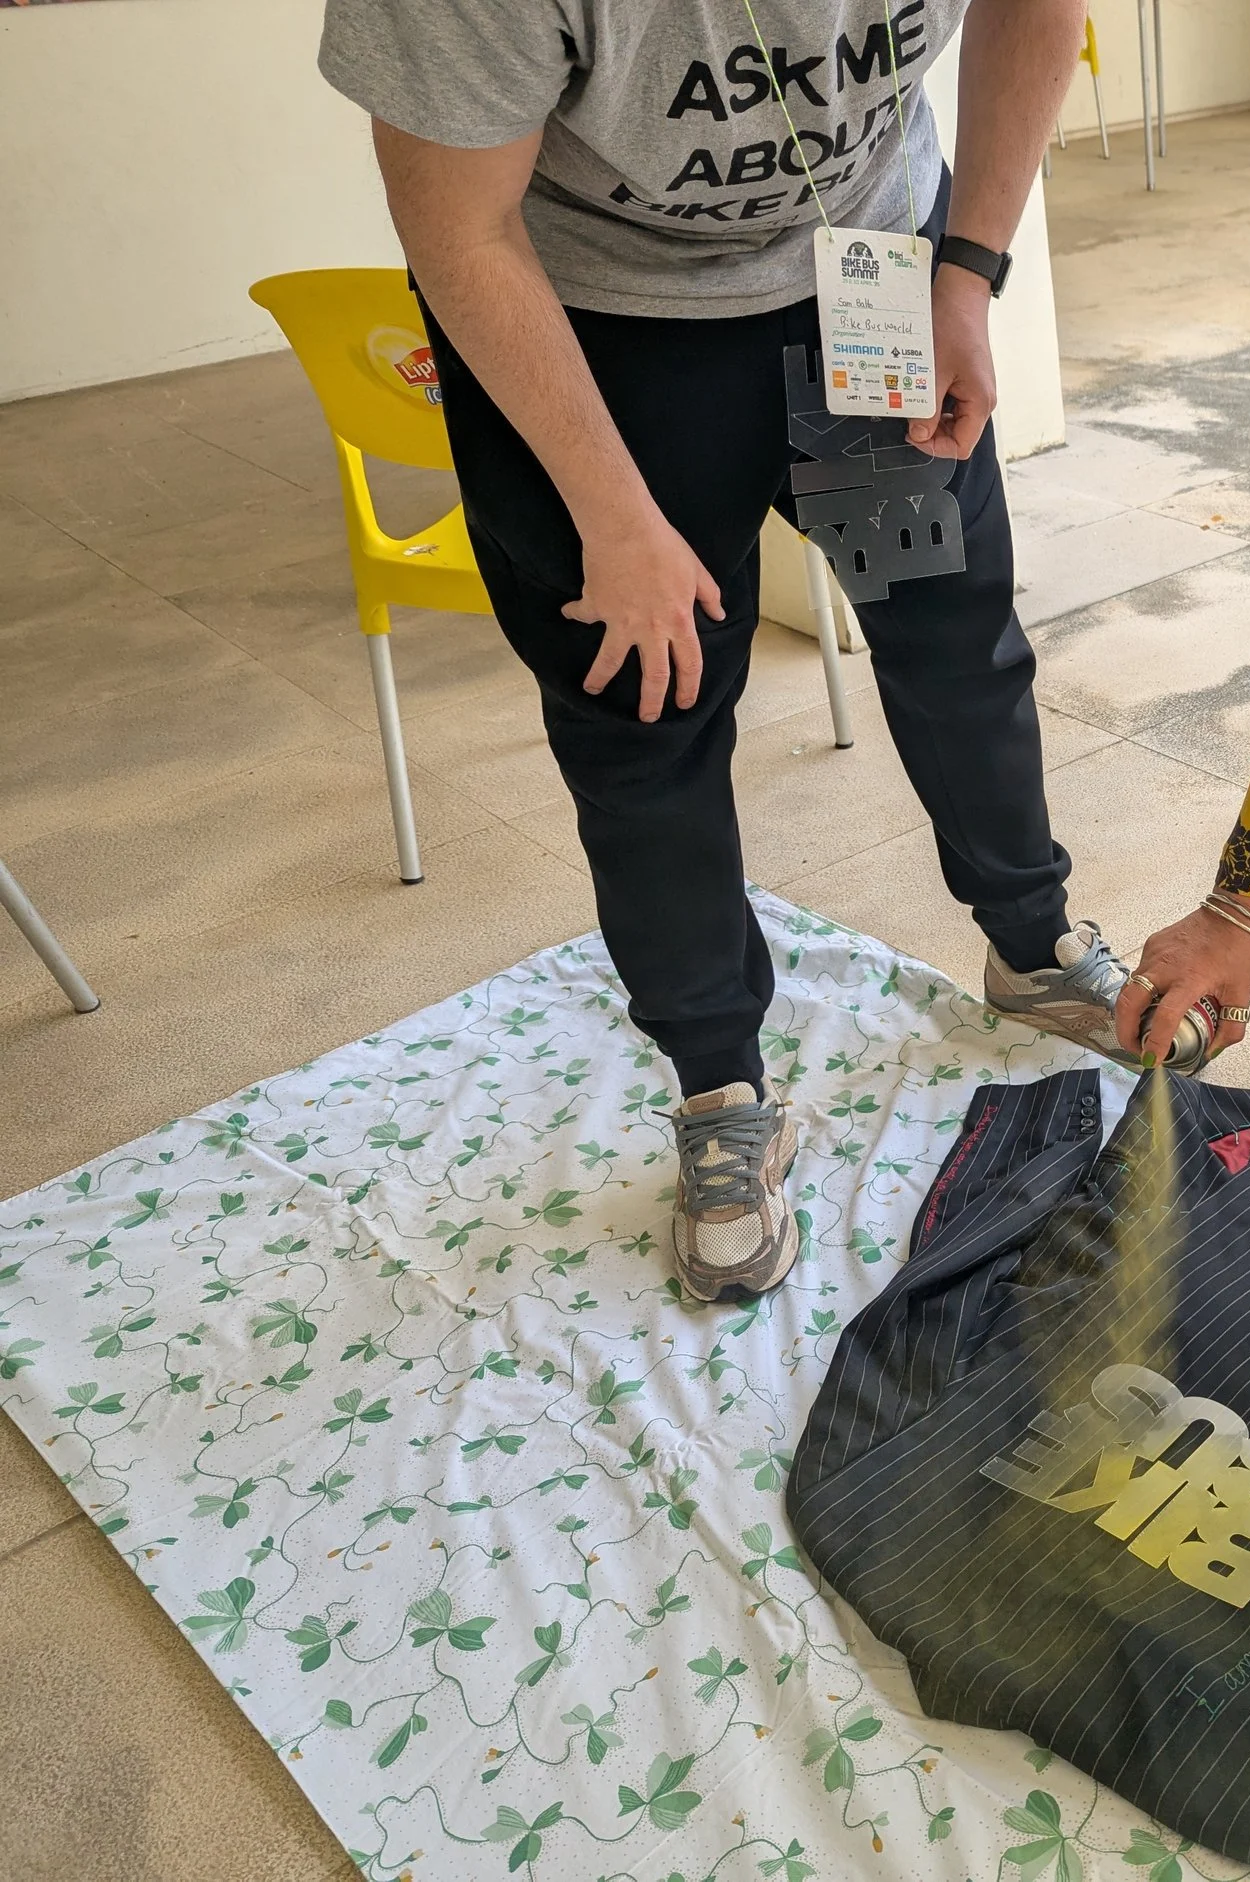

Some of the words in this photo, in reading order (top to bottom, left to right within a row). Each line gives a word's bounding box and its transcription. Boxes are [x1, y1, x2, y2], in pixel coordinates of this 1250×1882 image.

[667, 45, 828, 121] ASK
[836, 0, 926, 93] ME
[665, 81, 911, 191] ABOUT
[841, 257, 861, 268] BIKE
[862, 259, 880, 270] BUS
[841, 268, 880, 280] SUMMIT
[840, 315, 861, 330] Bike
[865, 319, 880, 331] Bus
[833, 343, 884, 356] SHIMANO
[400, 357, 436, 379] Lipt
